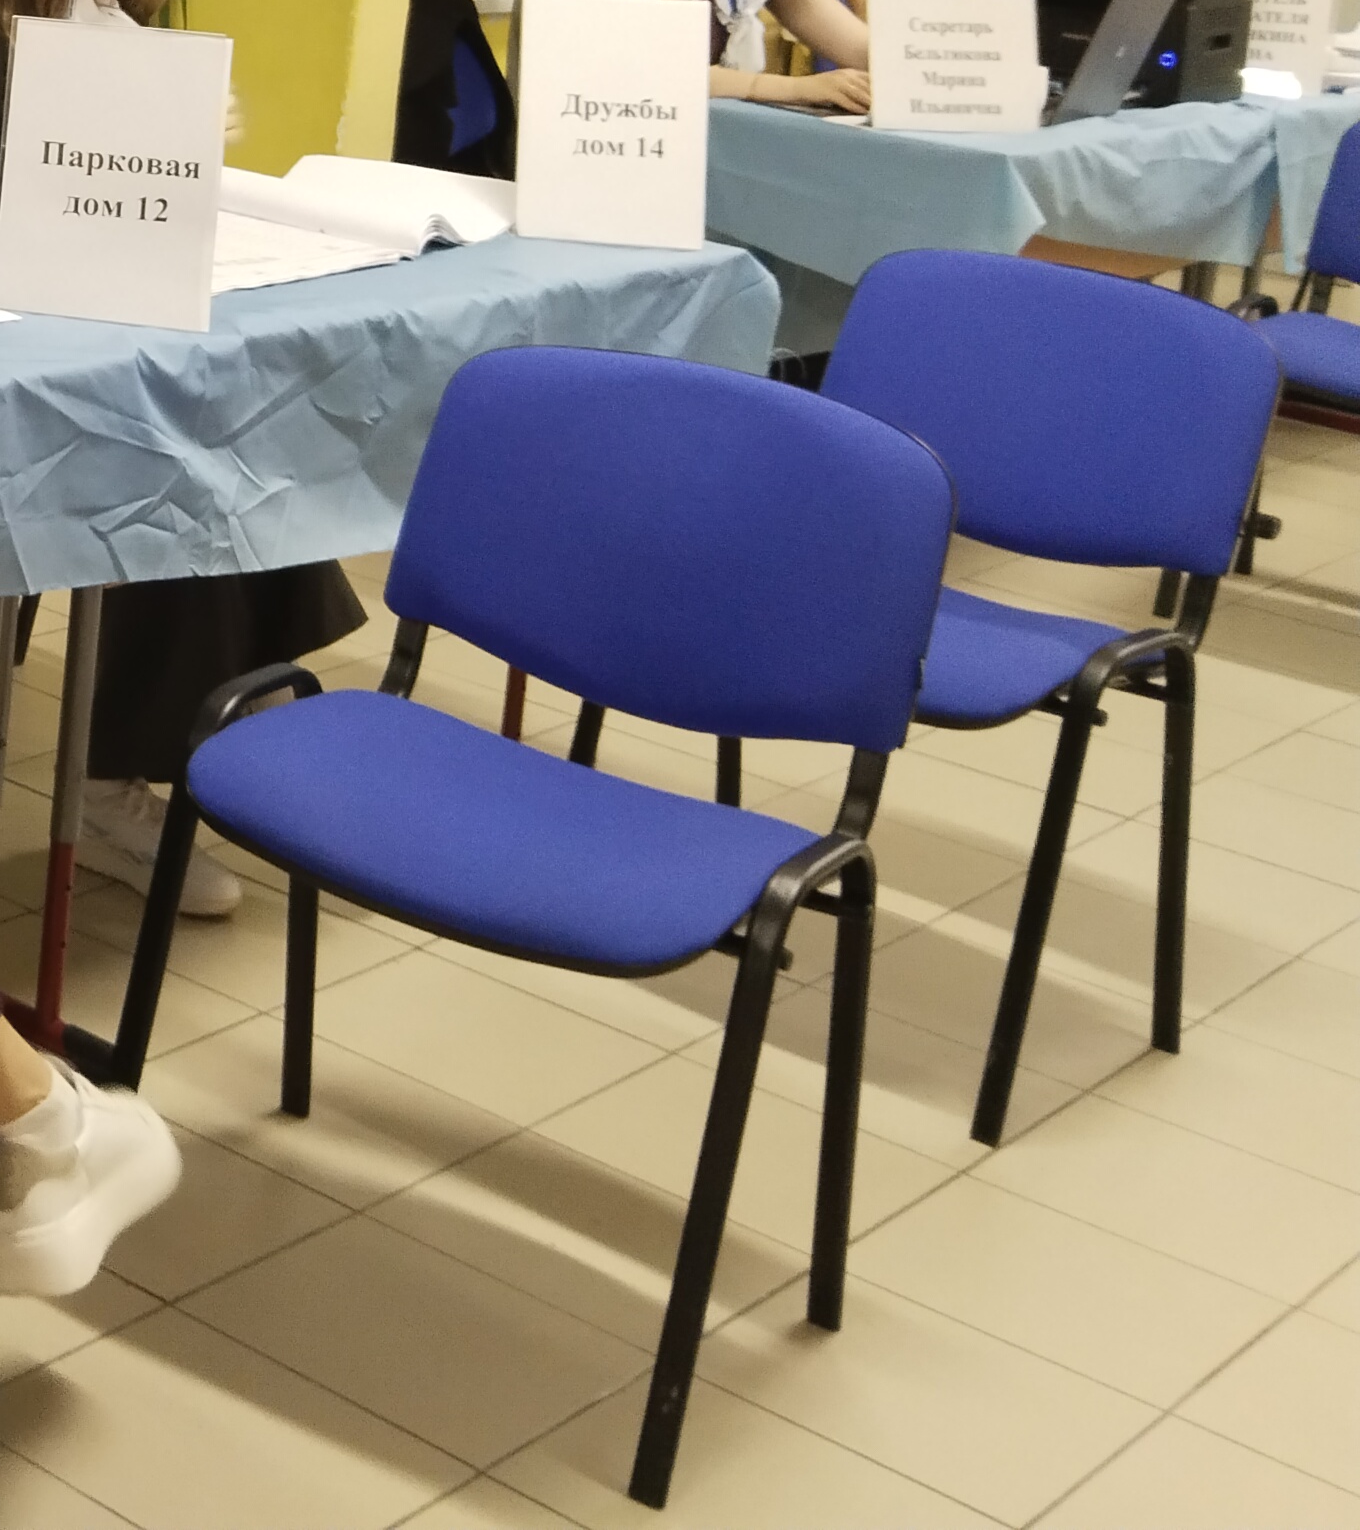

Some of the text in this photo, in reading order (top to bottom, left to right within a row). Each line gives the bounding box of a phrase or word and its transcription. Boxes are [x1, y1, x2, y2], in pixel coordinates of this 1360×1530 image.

[560, 93, 679, 122] Дружбы
[41, 140, 201, 179] Парковая
[572, 136, 665, 159] дом 14
[62, 196, 169, 222] дом 12
